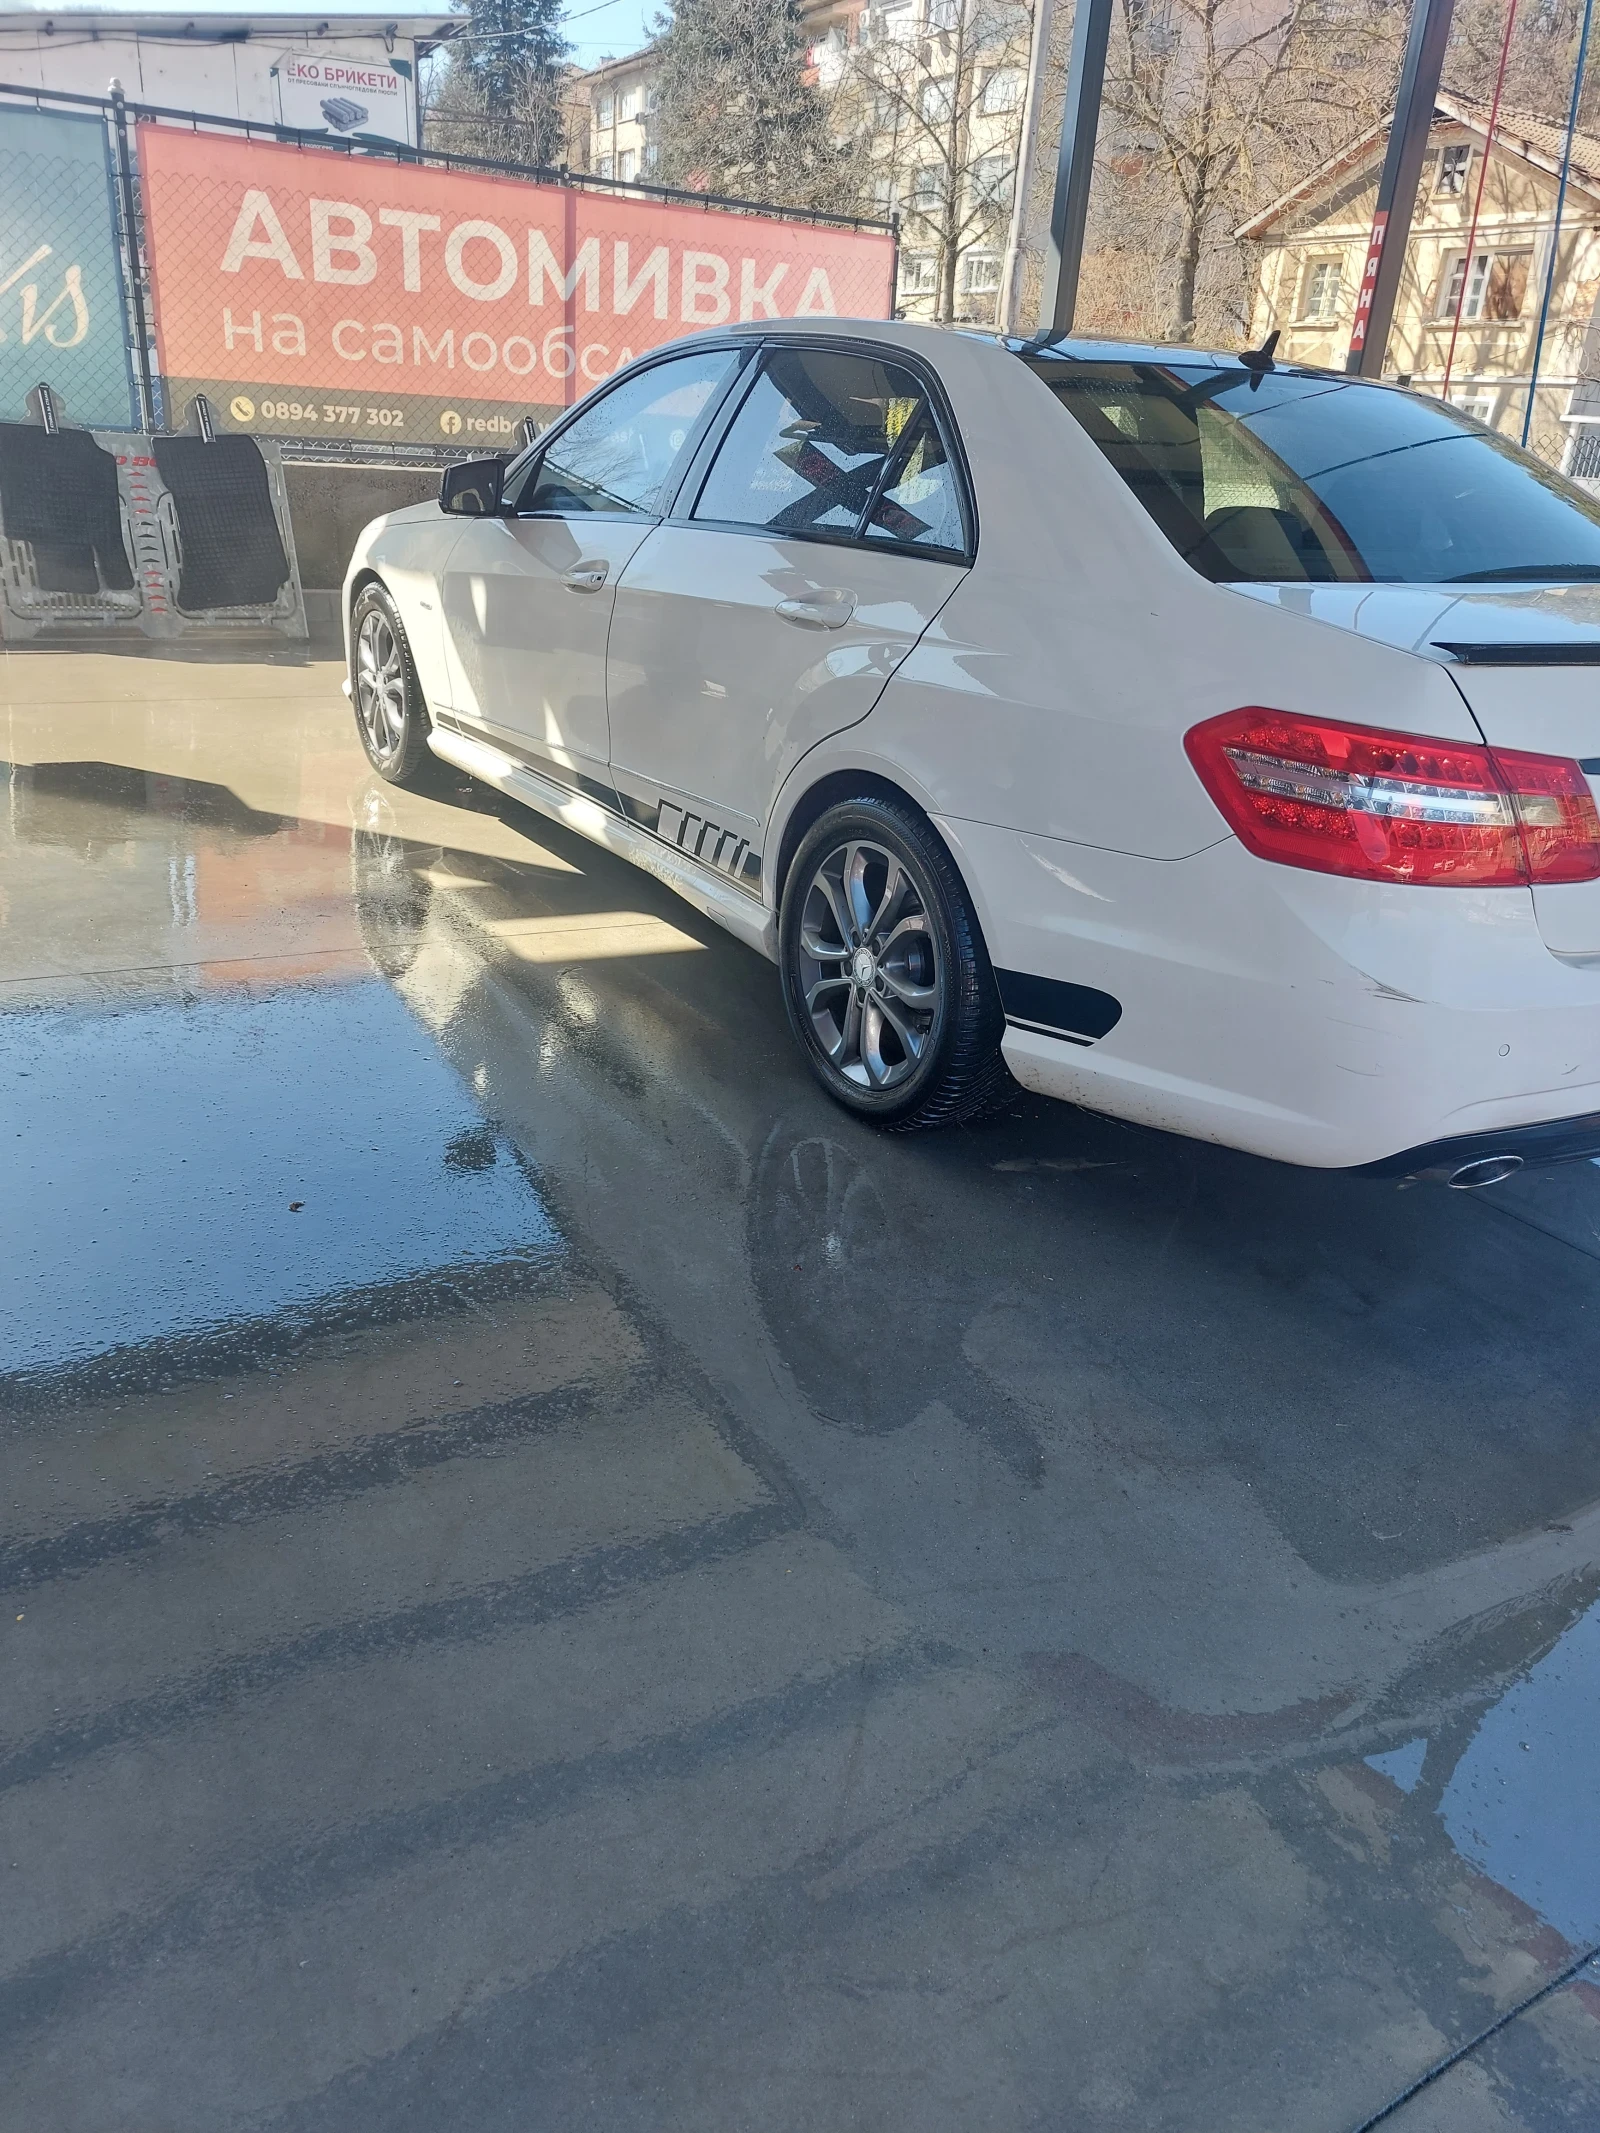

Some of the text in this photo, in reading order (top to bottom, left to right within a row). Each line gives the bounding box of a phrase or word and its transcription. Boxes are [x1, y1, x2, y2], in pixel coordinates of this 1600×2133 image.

[324, 67, 397, 89] БРИКЕТИ
[220, 189, 840, 326] АВТОМИВКА
[1352, 224, 1386, 340] ПЯНА
[222, 306, 648, 383] на самообсл
[260, 402, 404, 428] 0894 377 302
